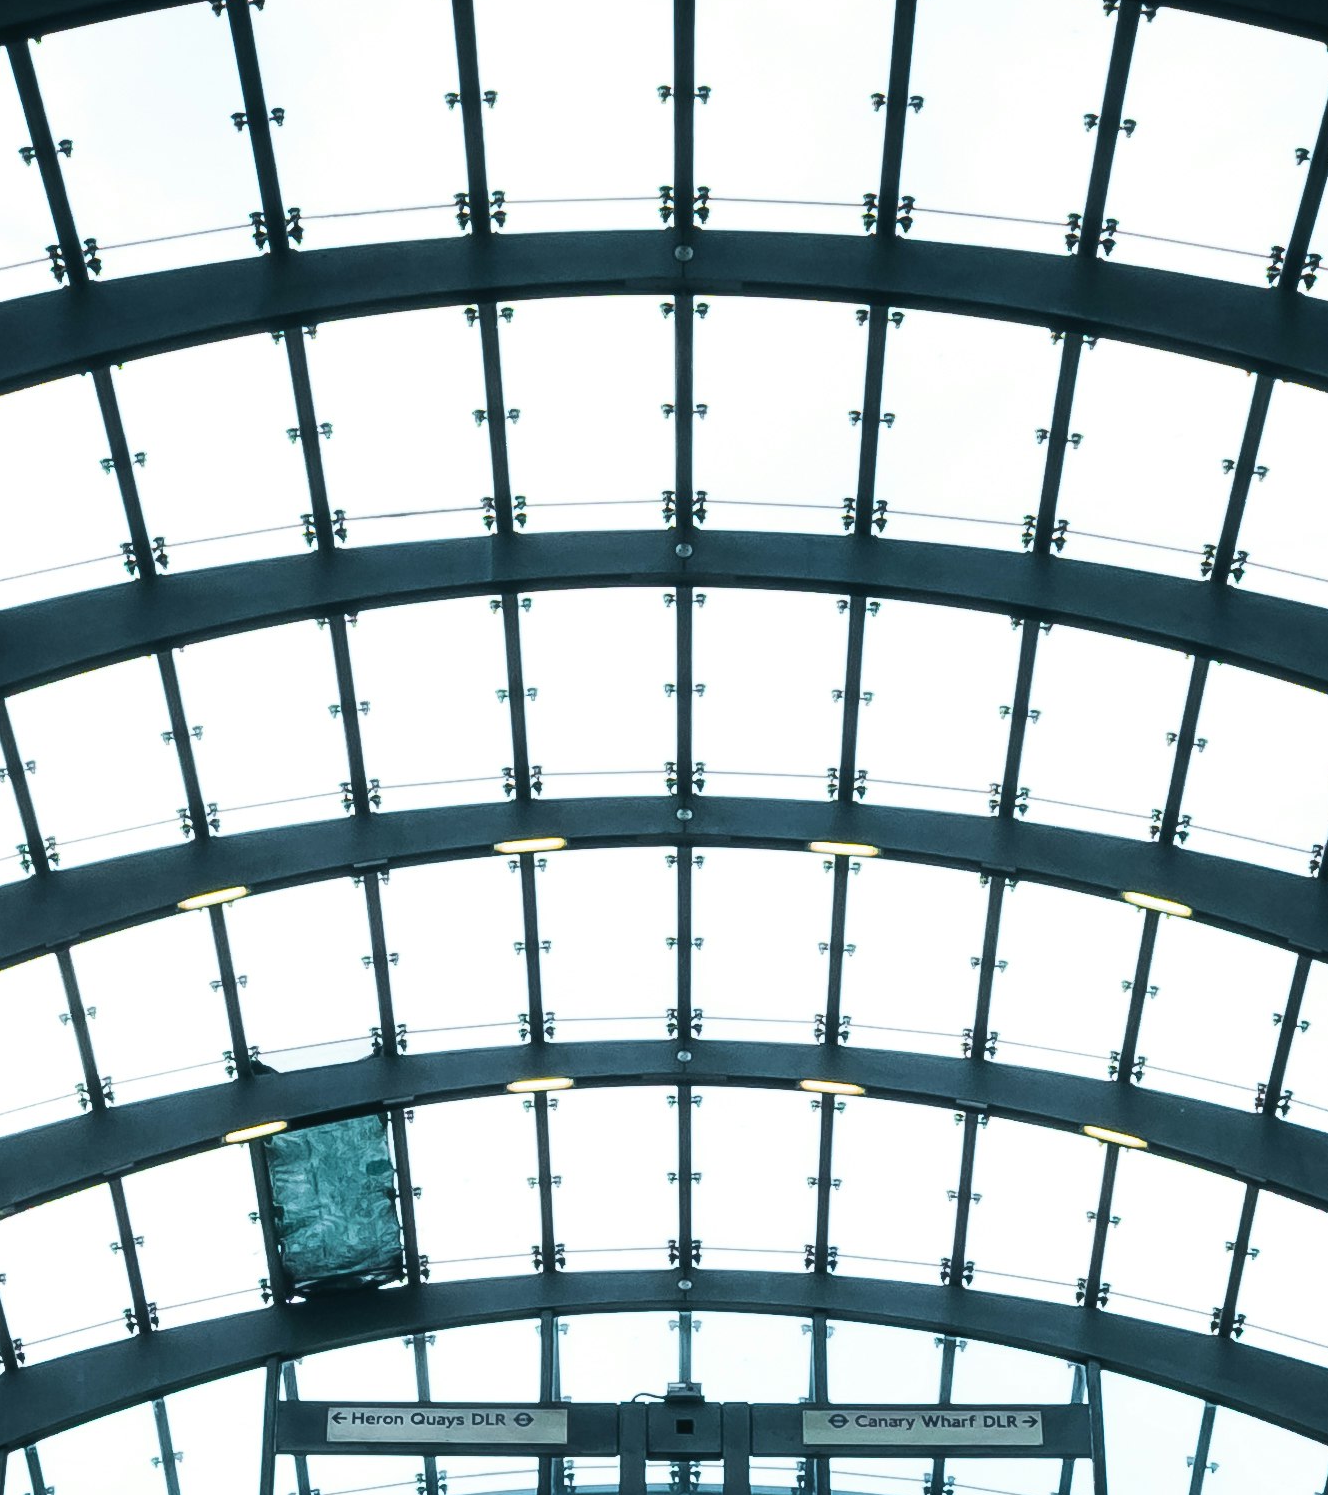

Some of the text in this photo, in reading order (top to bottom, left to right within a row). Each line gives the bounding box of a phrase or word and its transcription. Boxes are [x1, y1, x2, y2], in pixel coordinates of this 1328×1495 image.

[351, 1412, 404, 1425] Heron
[410, 1412, 465, 1429] Quays
[472, 1413, 506, 1426] DLR
[855, 1414, 1018, 1430] Canary Wharf DLR
